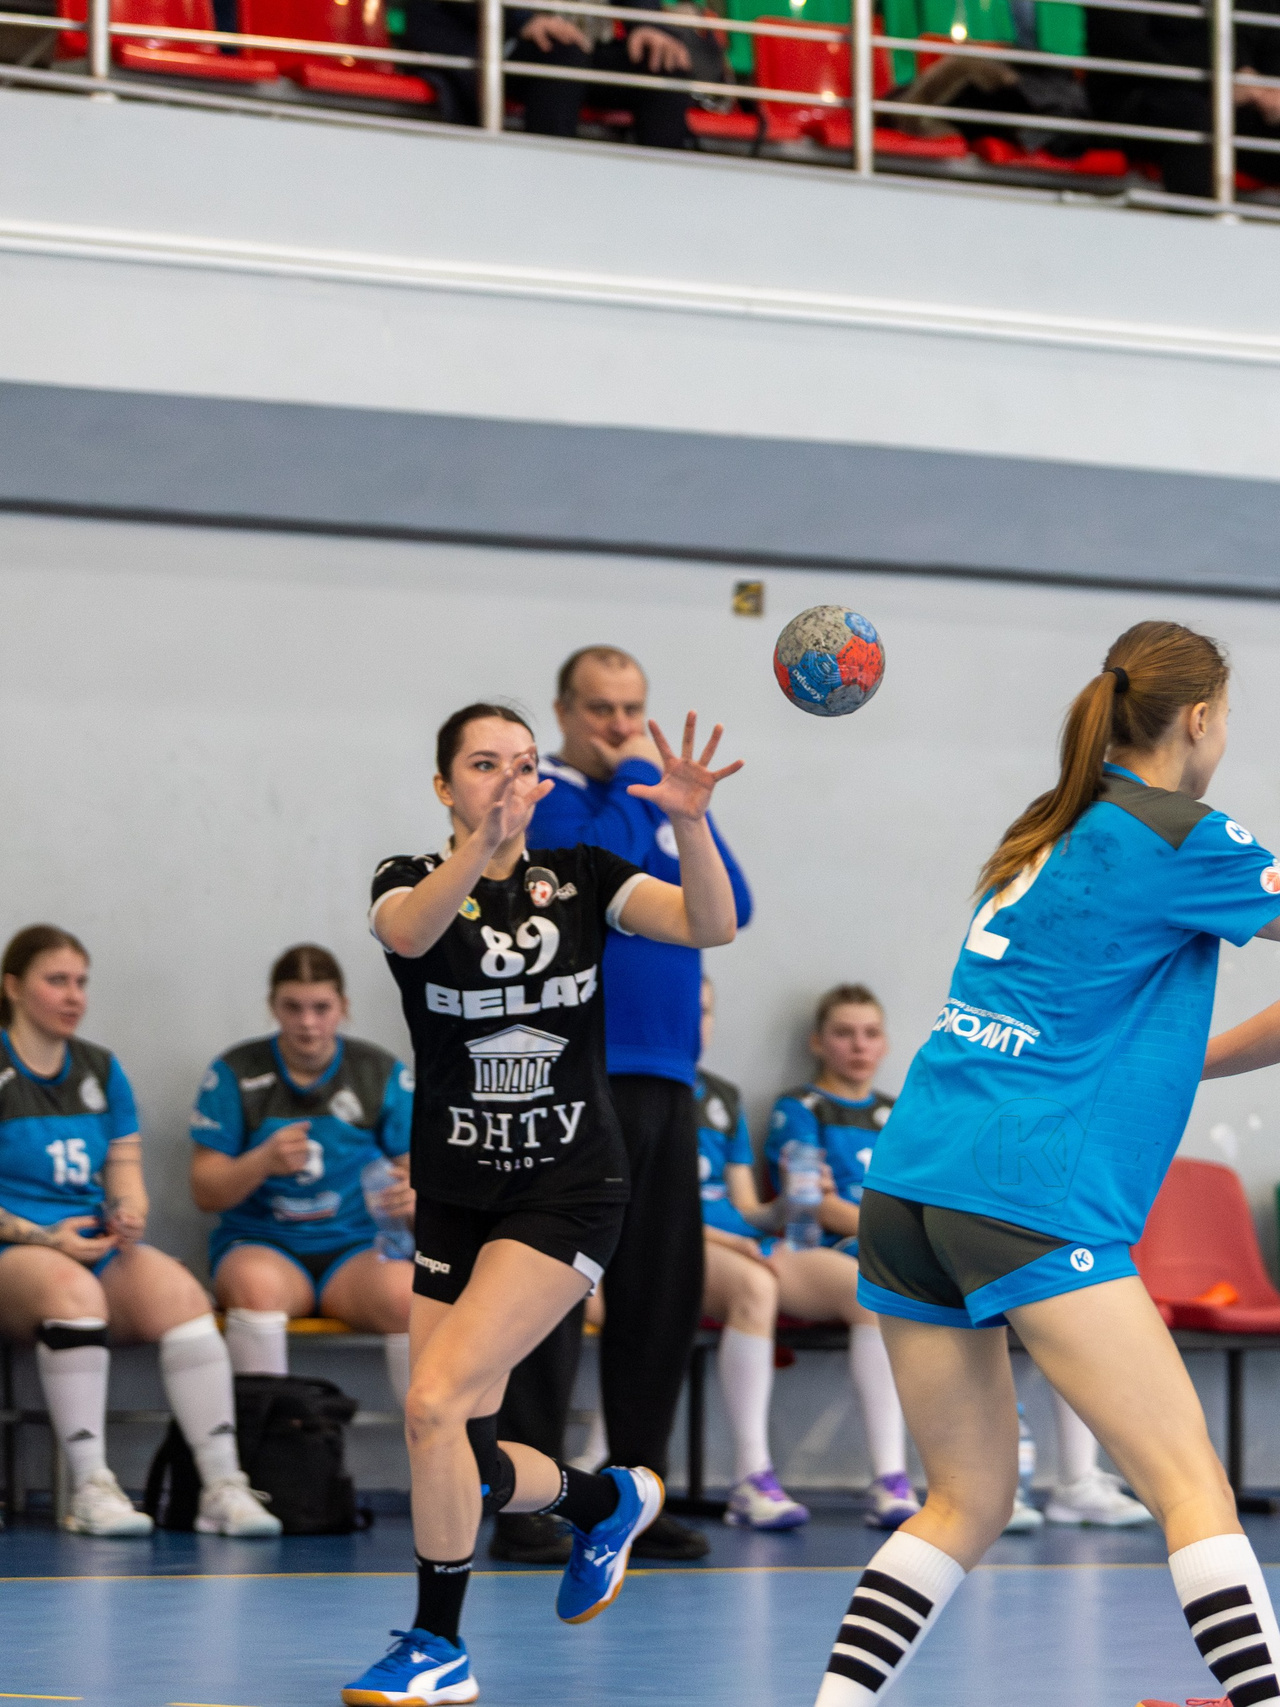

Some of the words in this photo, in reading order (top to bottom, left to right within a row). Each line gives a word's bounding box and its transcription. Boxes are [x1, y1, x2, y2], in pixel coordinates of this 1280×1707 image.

[965, 843, 1053, 960] 2
[480, 915, 561, 979] 89
[425, 963, 599, 1021] BELAZ
[446, 1100, 586, 1153] БНТУ
[46, 1138, 91, 1186] 15
